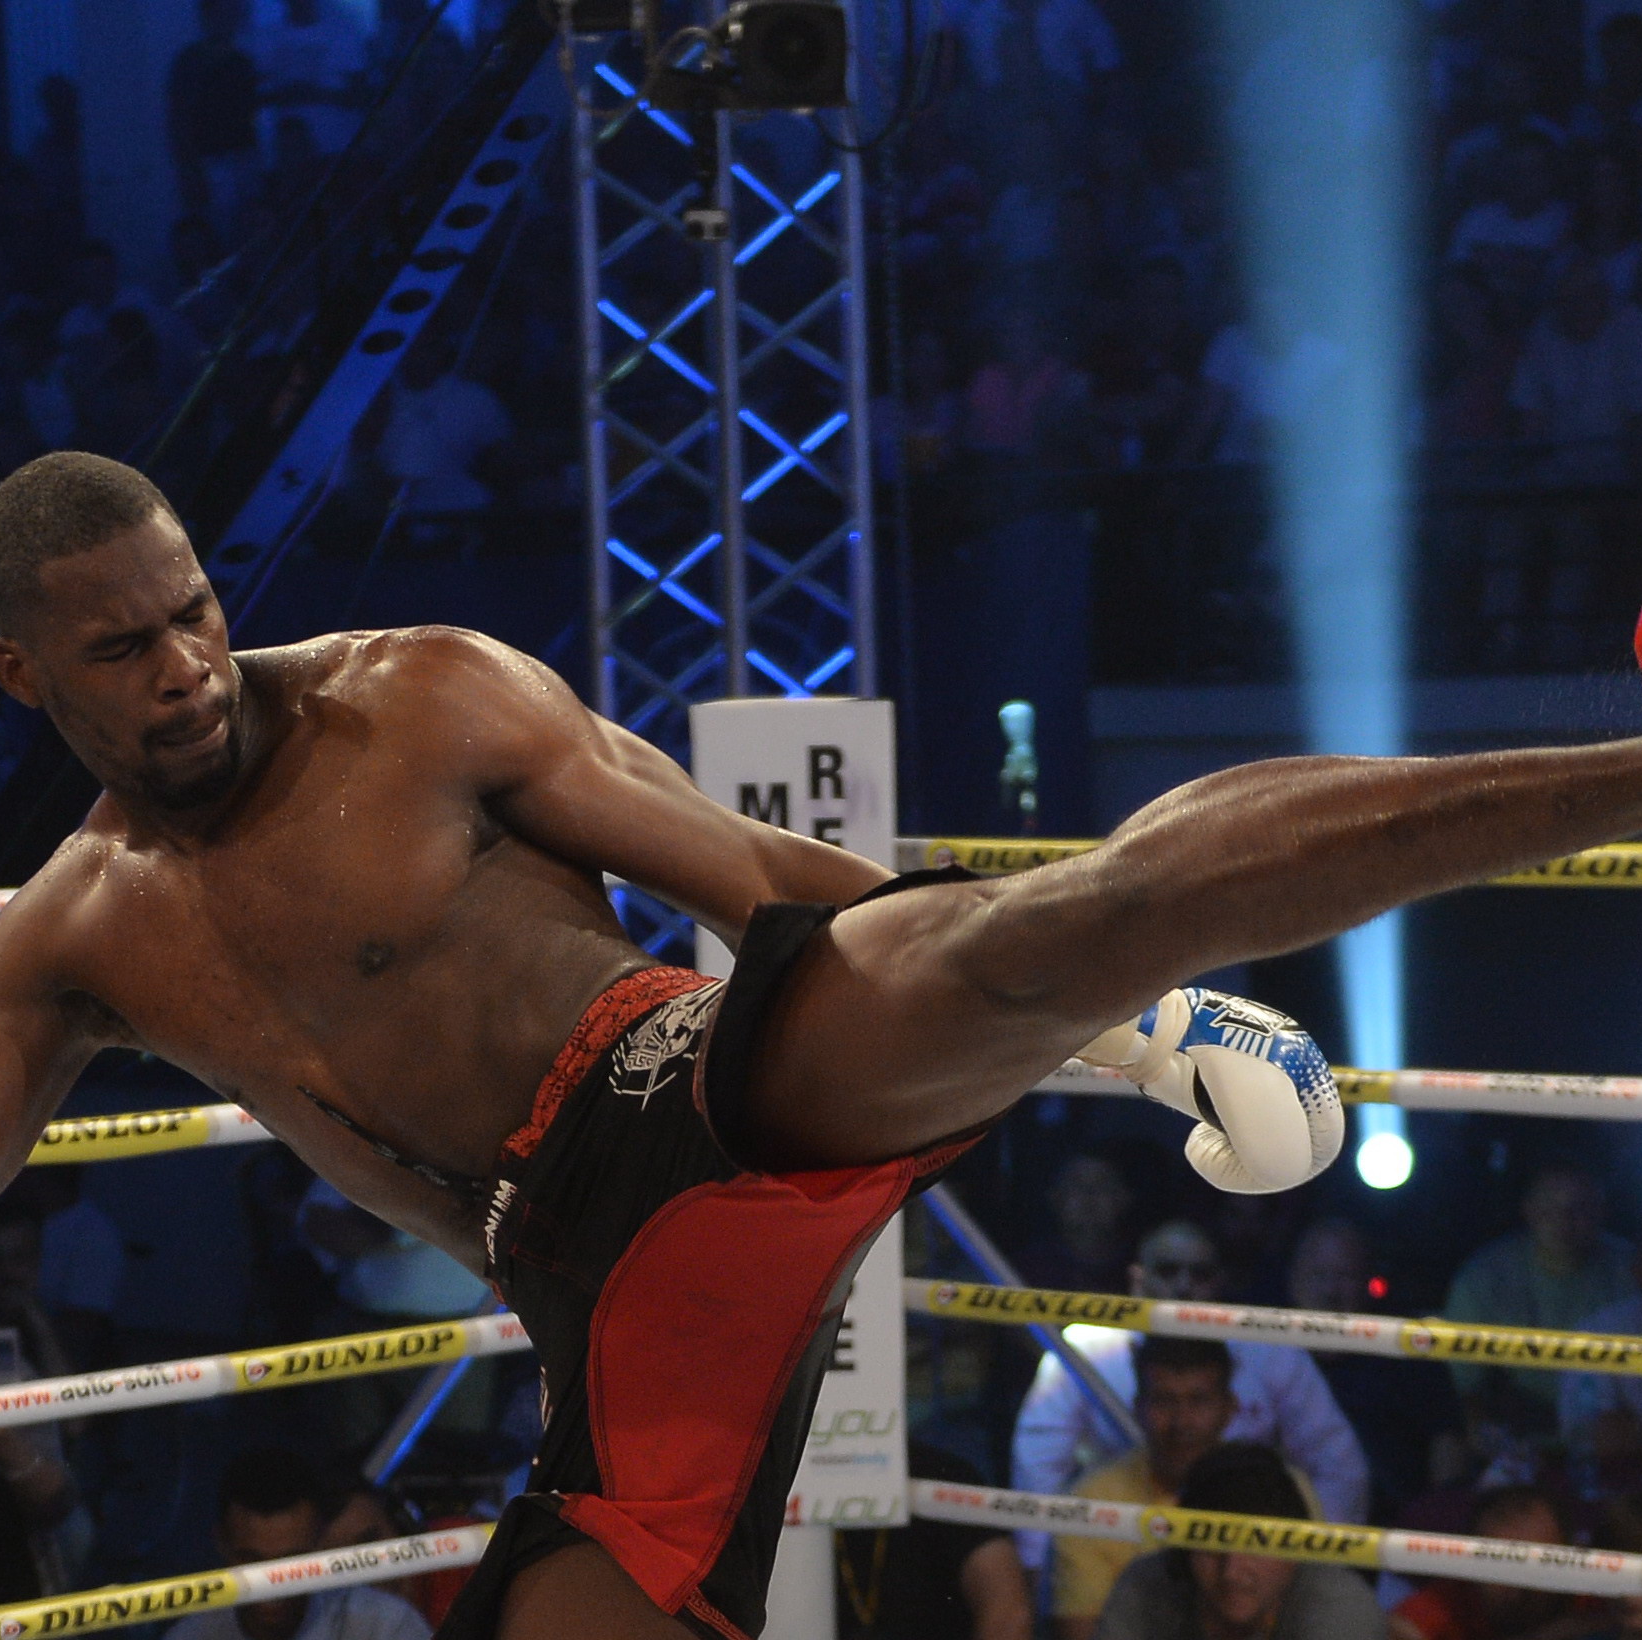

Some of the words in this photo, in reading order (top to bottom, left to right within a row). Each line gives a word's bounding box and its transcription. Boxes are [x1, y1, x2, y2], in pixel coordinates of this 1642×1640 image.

[965, 1285, 1143, 1323] DUNLOP
[279, 1327, 455, 1377] DUNLOP
[1185, 1520, 1369, 1557] DUNLOP
[41, 1577, 225, 1634] DUNLOP
